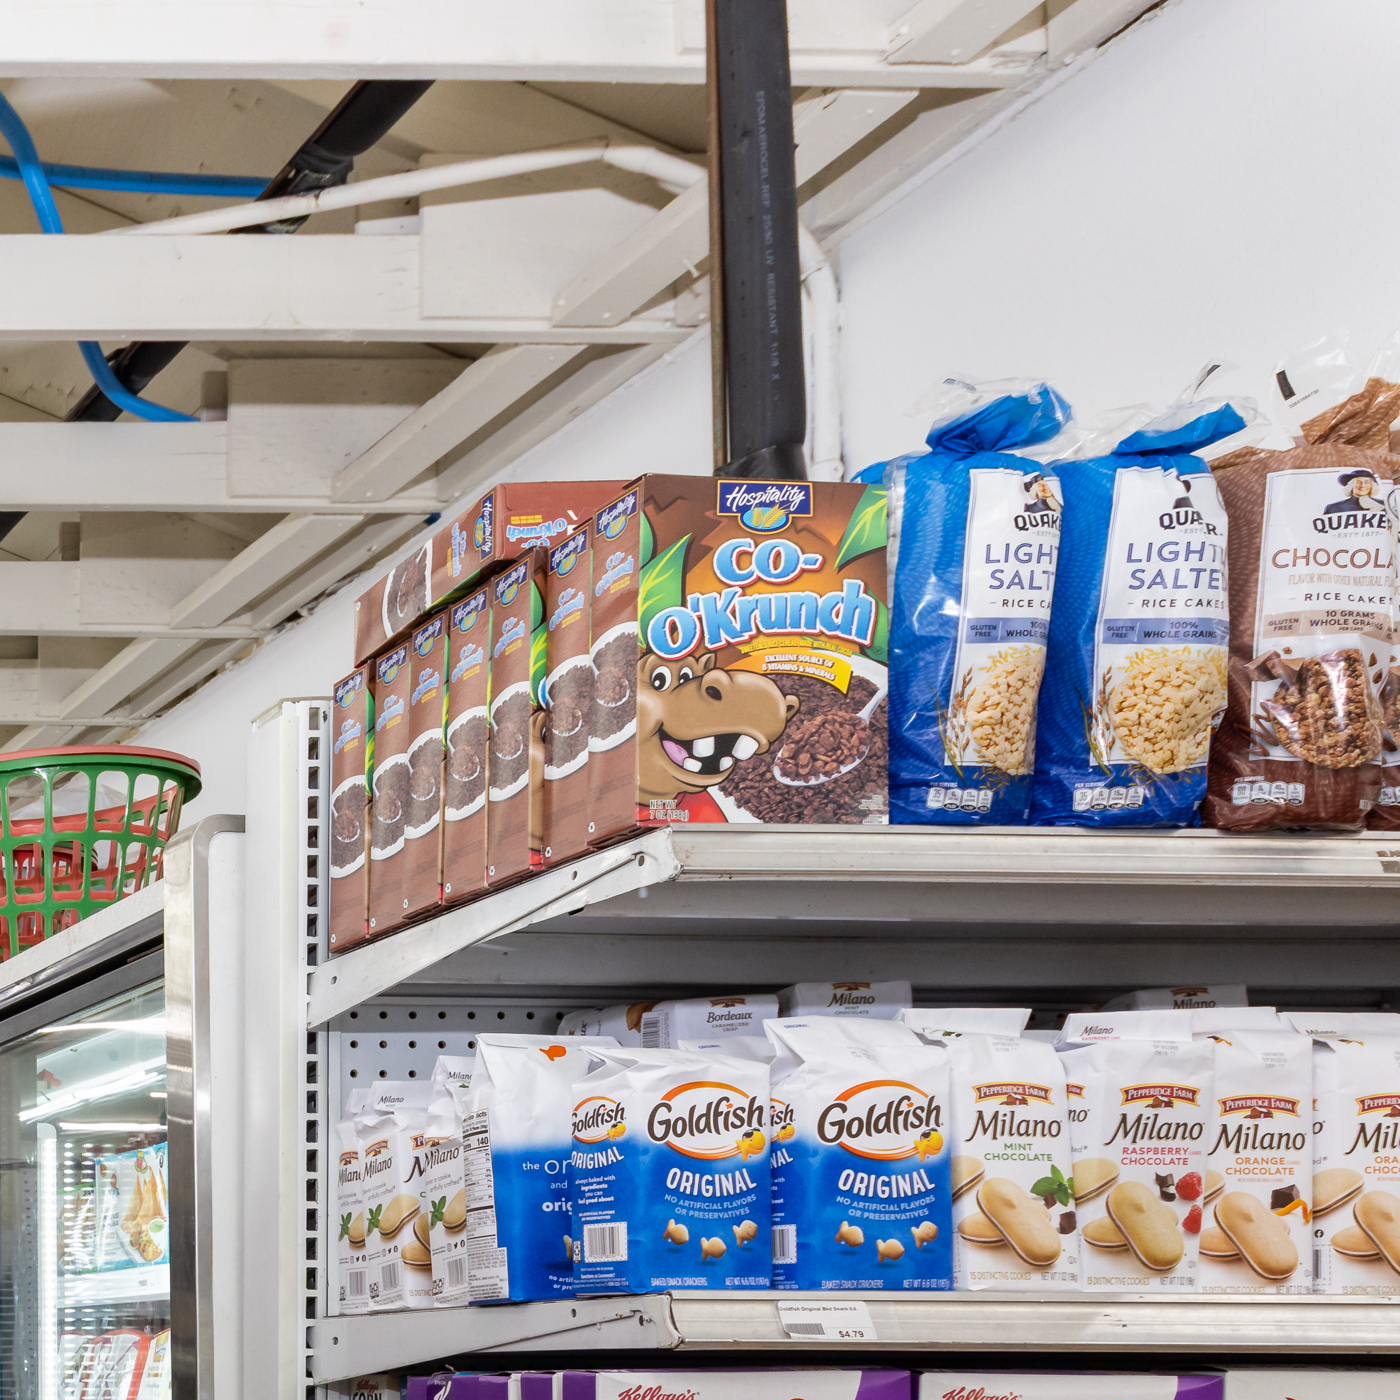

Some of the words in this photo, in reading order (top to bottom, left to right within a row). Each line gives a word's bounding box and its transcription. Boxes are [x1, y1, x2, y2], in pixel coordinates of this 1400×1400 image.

[725, 484, 806, 513] Hospitality
[713, 537, 824, 586] CO-
[1142, 599, 1177, 608] RICE
[647, 578, 876, 661] O'Krunch
[1325, 610, 1337, 618] 10
[1340, 611, 1376, 620] GRAMS
[1143, 630, 1181, 639] WHOLE
[1183, 630, 1217, 639] GRAINS
[765, 654, 798, 664] EXCELLENT
[798, 655, 823, 667] SOURCE
[824, 659, 834, 667] OF
[768, 663, 797, 673] VITAMINS
[798, 665, 804, 673] &
[805, 665, 836, 681] MINERALS
[828, 992, 875, 1007] Milano
[706, 1011, 753, 1024] Bordeaux
[711, 1021, 748, 1029] CARAMELIZED
[979, 1085, 1017, 1098] PEPPERIDGE
[1020, 1086, 1050, 1099] FARM
[648, 1096, 766, 1143] Goldfish
[965, 1109, 1061, 1141] Milano
[1003, 1142, 1033, 1152] MINT
[1122, 1146, 1188, 1157] RASPBERRY
[984, 1151, 1053, 1162] CHOCOLATE
[1235, 1157, 1285, 1166] ORANGE
[666, 1167, 757, 1198] ORIGINAL
[664, 1194, 678, 1204] NO
[678, 1200, 723, 1211] ARTIFICIAL
[722, 1194, 757, 1209] FLAVORS
[675, 1207, 687, 1216] OR
[689, 1207, 750, 1220] PRESERVATIVES
[651, 1277, 667, 1286] BAKED
[667, 1277, 683, 1286] SNACK
[683, 1277, 707, 1286] CRACKERS
[838, 1330, 864, 1339] $4.79
